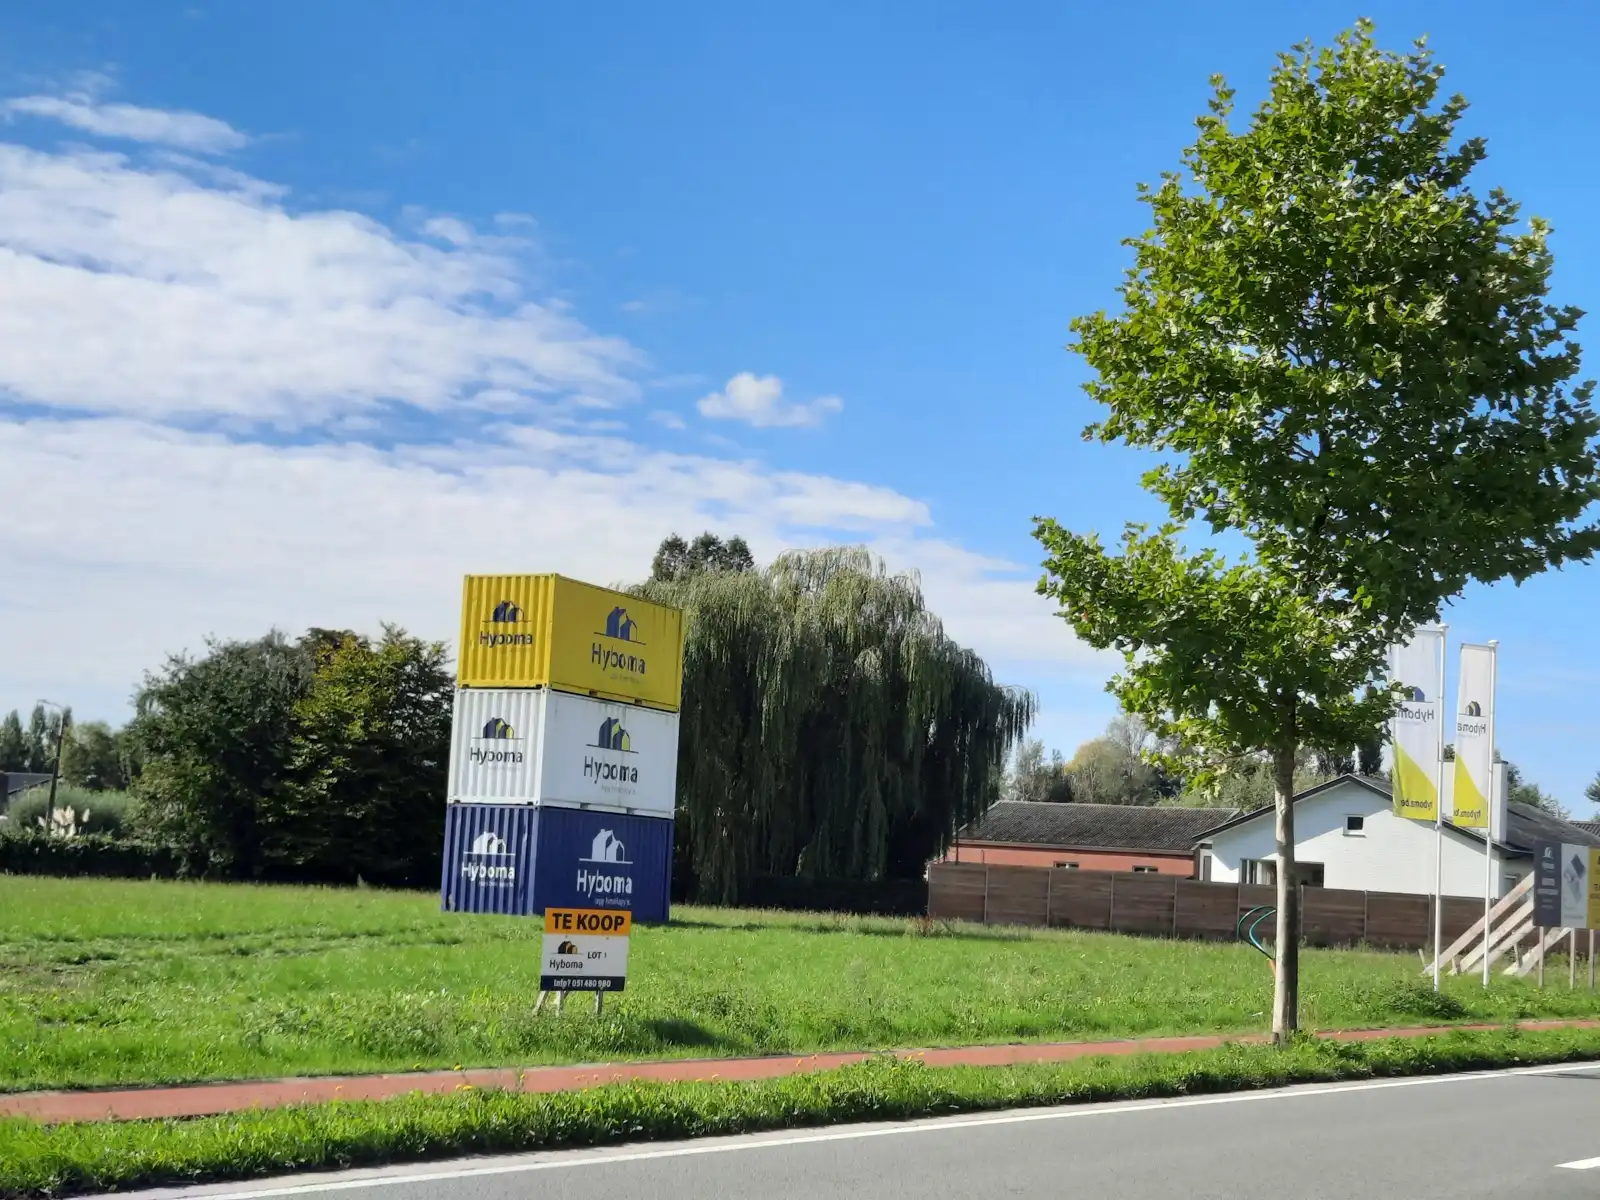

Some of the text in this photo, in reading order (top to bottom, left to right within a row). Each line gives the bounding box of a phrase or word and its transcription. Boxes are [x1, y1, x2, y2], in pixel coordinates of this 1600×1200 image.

[479, 631, 533, 648] Hyboma
[591, 642, 646, 675] Hyboma
[469, 747, 523, 765] Hyboma
[583, 755, 638, 787] Hyboma
[461, 860, 515, 882] Hyboma
[576, 869, 632, 898] Hyboma
[552, 912, 625, 931] TE KOOP
[549, 959, 583, 971] Hyboma
[587, 951, 602, 960] LOT
